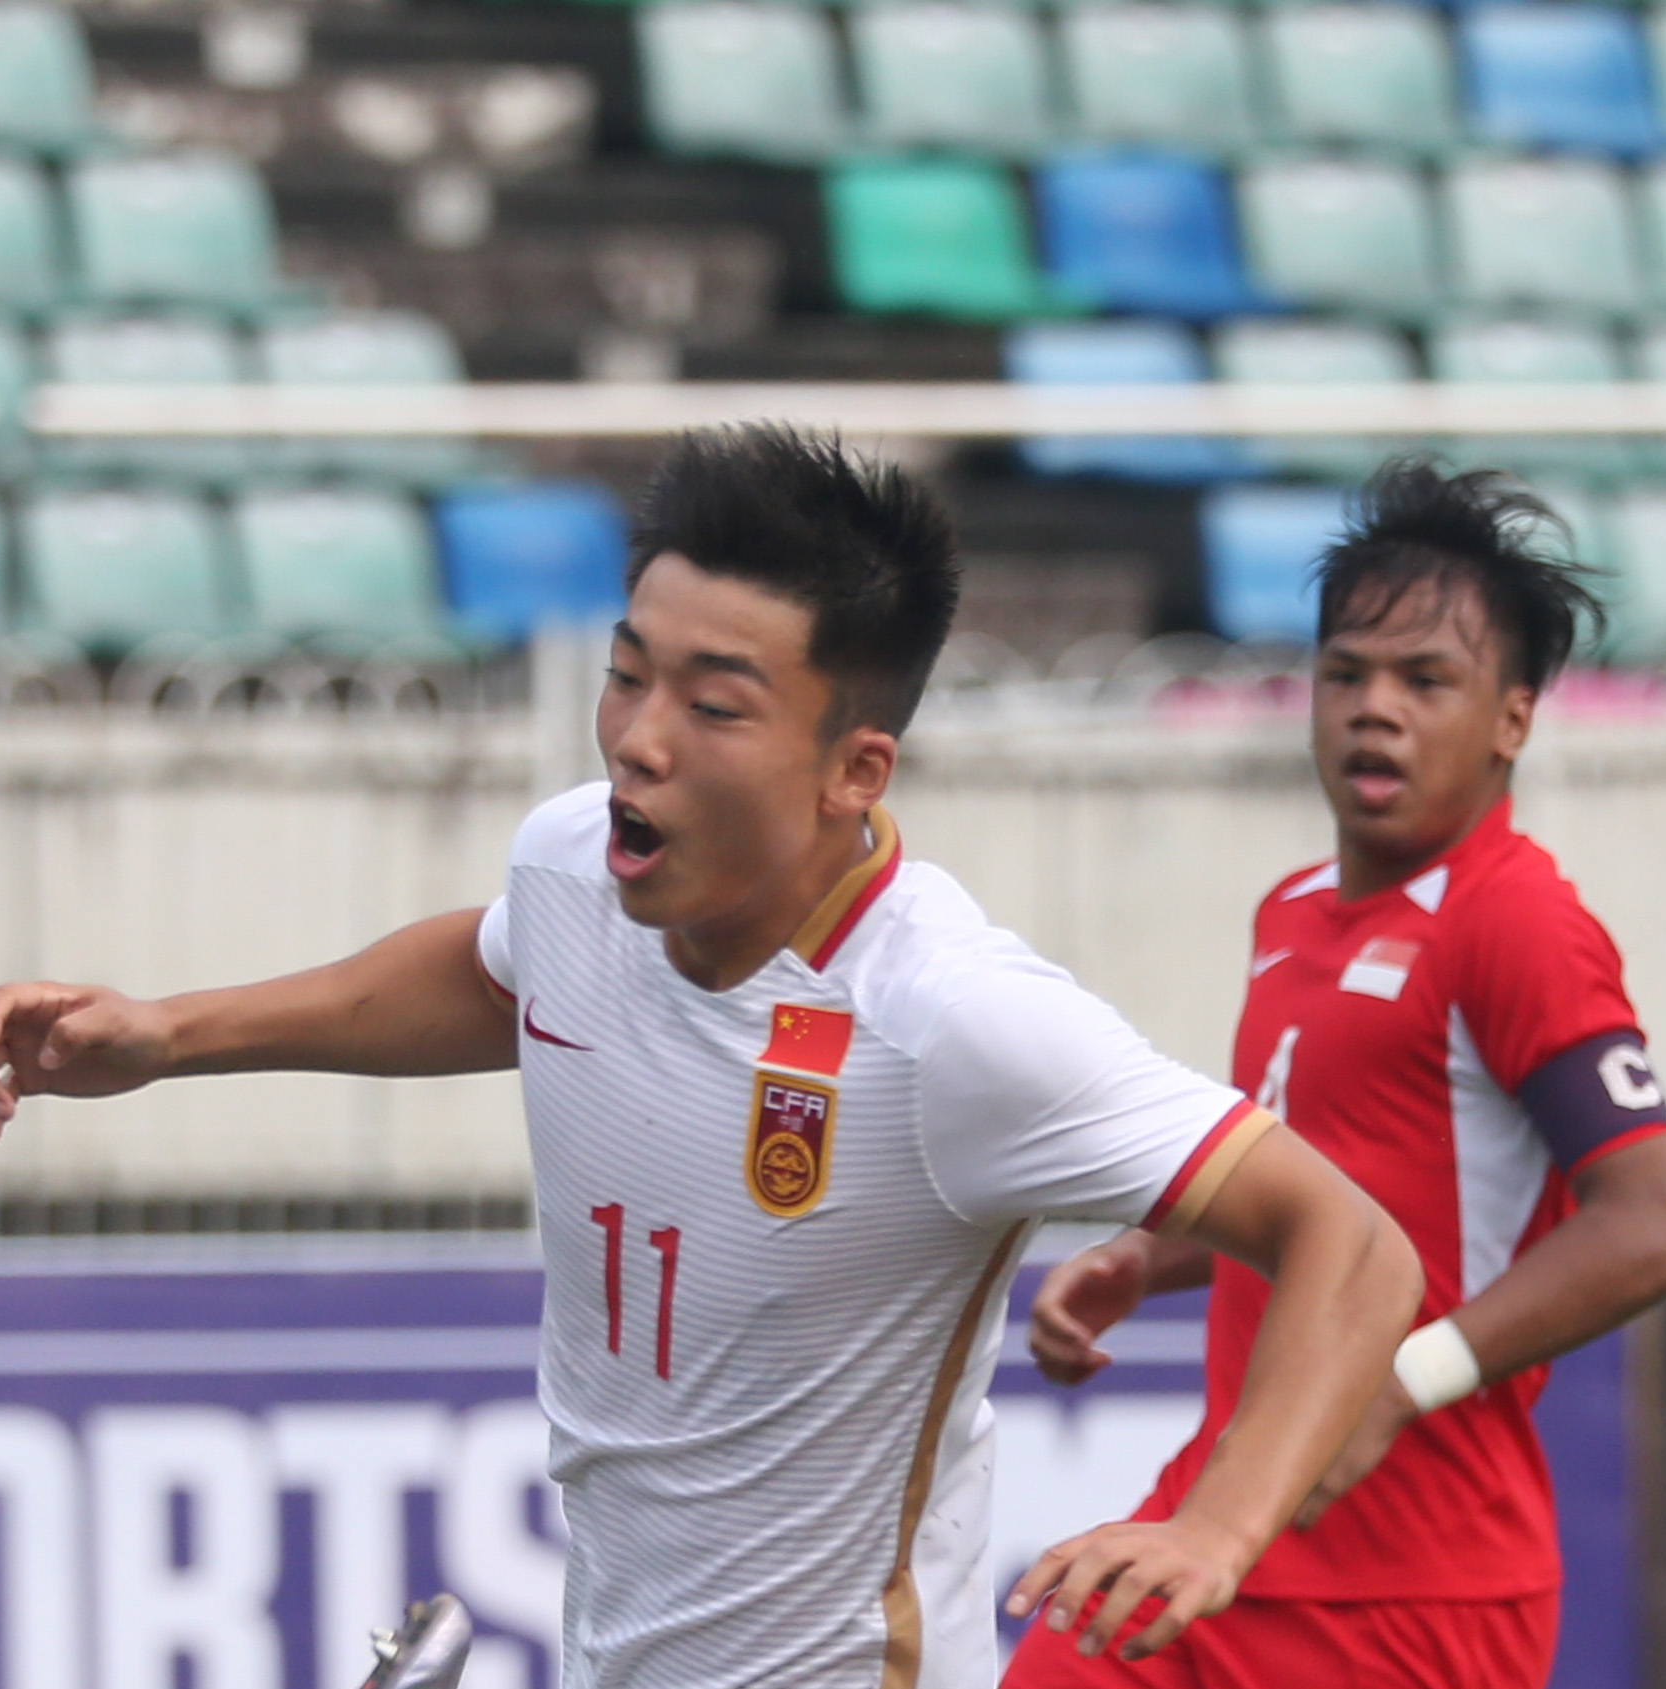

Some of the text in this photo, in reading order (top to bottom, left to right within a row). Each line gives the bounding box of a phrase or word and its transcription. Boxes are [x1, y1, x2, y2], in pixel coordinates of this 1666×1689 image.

[764, 1085, 827, 1120] CFA
[1597, 1043, 1662, 1111] C
[590, 1202, 682, 1382] 11
